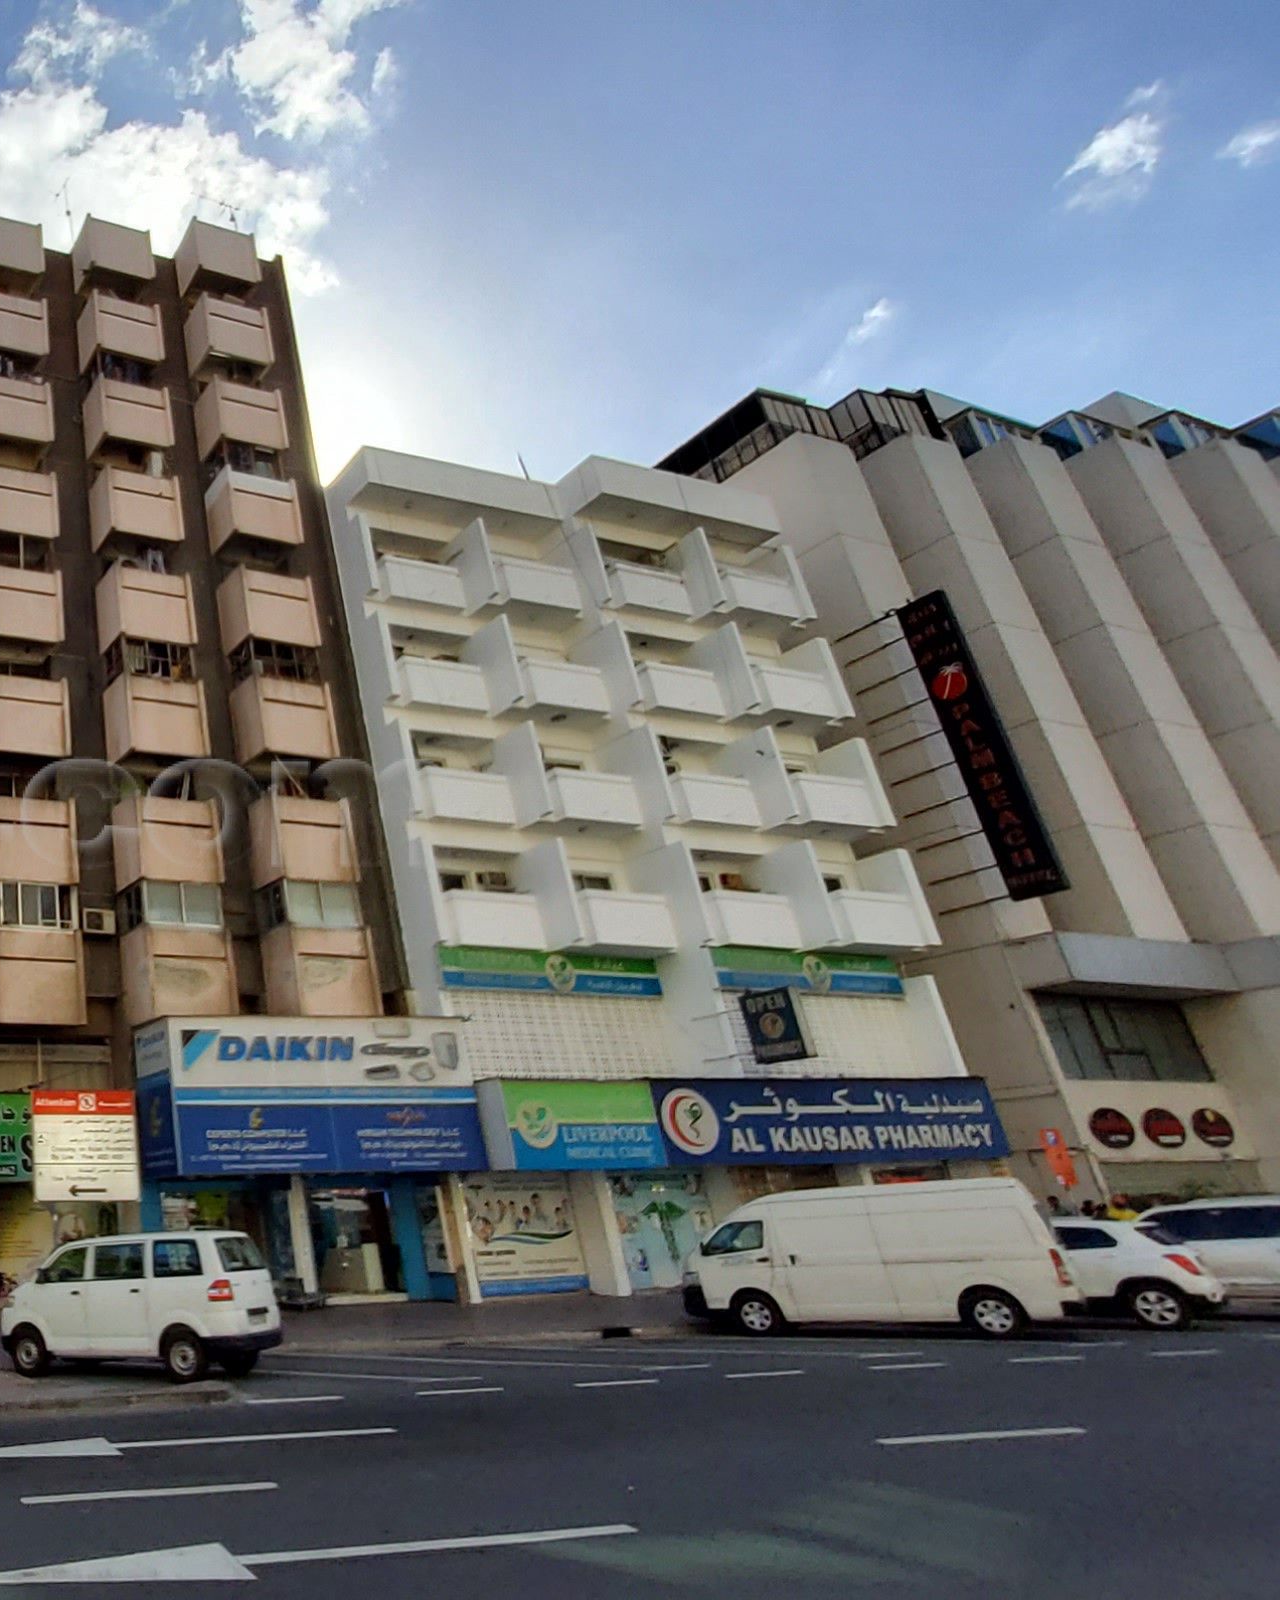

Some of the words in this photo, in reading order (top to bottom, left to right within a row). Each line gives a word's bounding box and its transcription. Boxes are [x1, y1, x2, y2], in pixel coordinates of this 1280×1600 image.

[745, 992, 786, 1013] OPEN
[217, 1035, 354, 1063] DAIKIN
[724, 1087, 896, 1122] الكوثر
[899, 1092, 984, 1119] صيدلية
[561, 1126, 653, 1143] LIVERPOOL
[731, 1127, 766, 1153] AL
[769, 1126, 873, 1152] KAUSAR
[877, 1124, 994, 1149] PHARMACY
